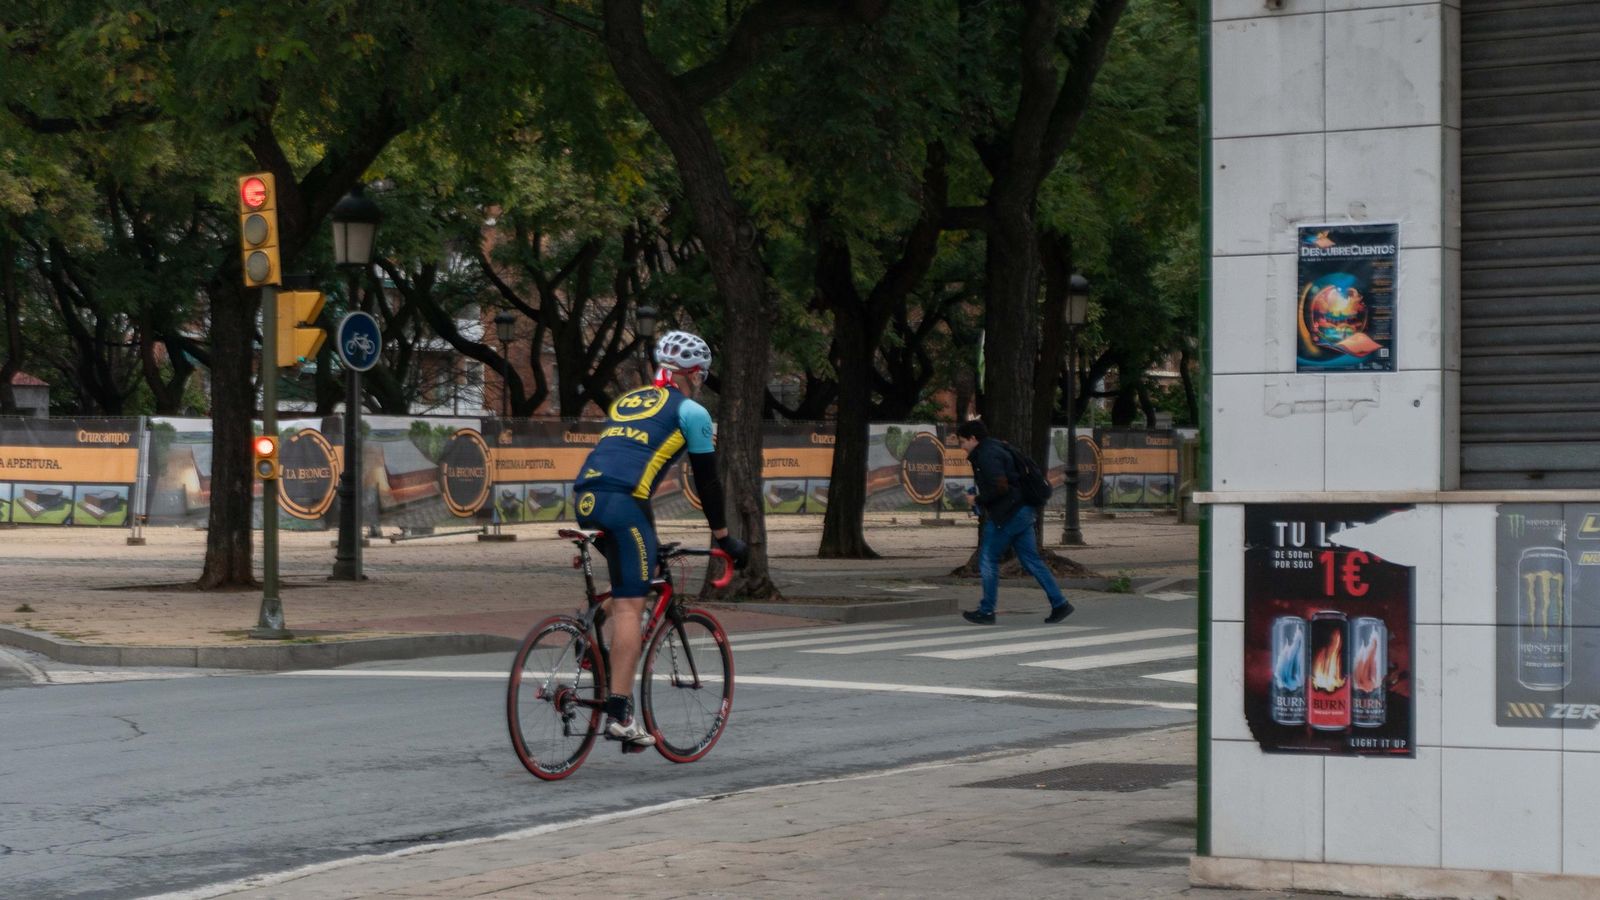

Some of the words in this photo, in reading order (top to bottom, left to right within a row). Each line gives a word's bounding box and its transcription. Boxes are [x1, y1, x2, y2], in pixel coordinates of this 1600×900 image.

[78, 429, 130, 445] Cruzcampo
[1274, 521, 1306, 547] TU
[1275, 550, 1285, 559] DE
[1288, 550, 1314, 559] 500ml
[1275, 560, 1291, 568] POR
[1276, 696, 1305, 708] BURN
[1313, 698, 1346, 711] BURN
[1351, 738, 1377, 747] LIGHT
[1381, 739, 1390, 748] IT
[1394, 739, 1407, 749] UP
